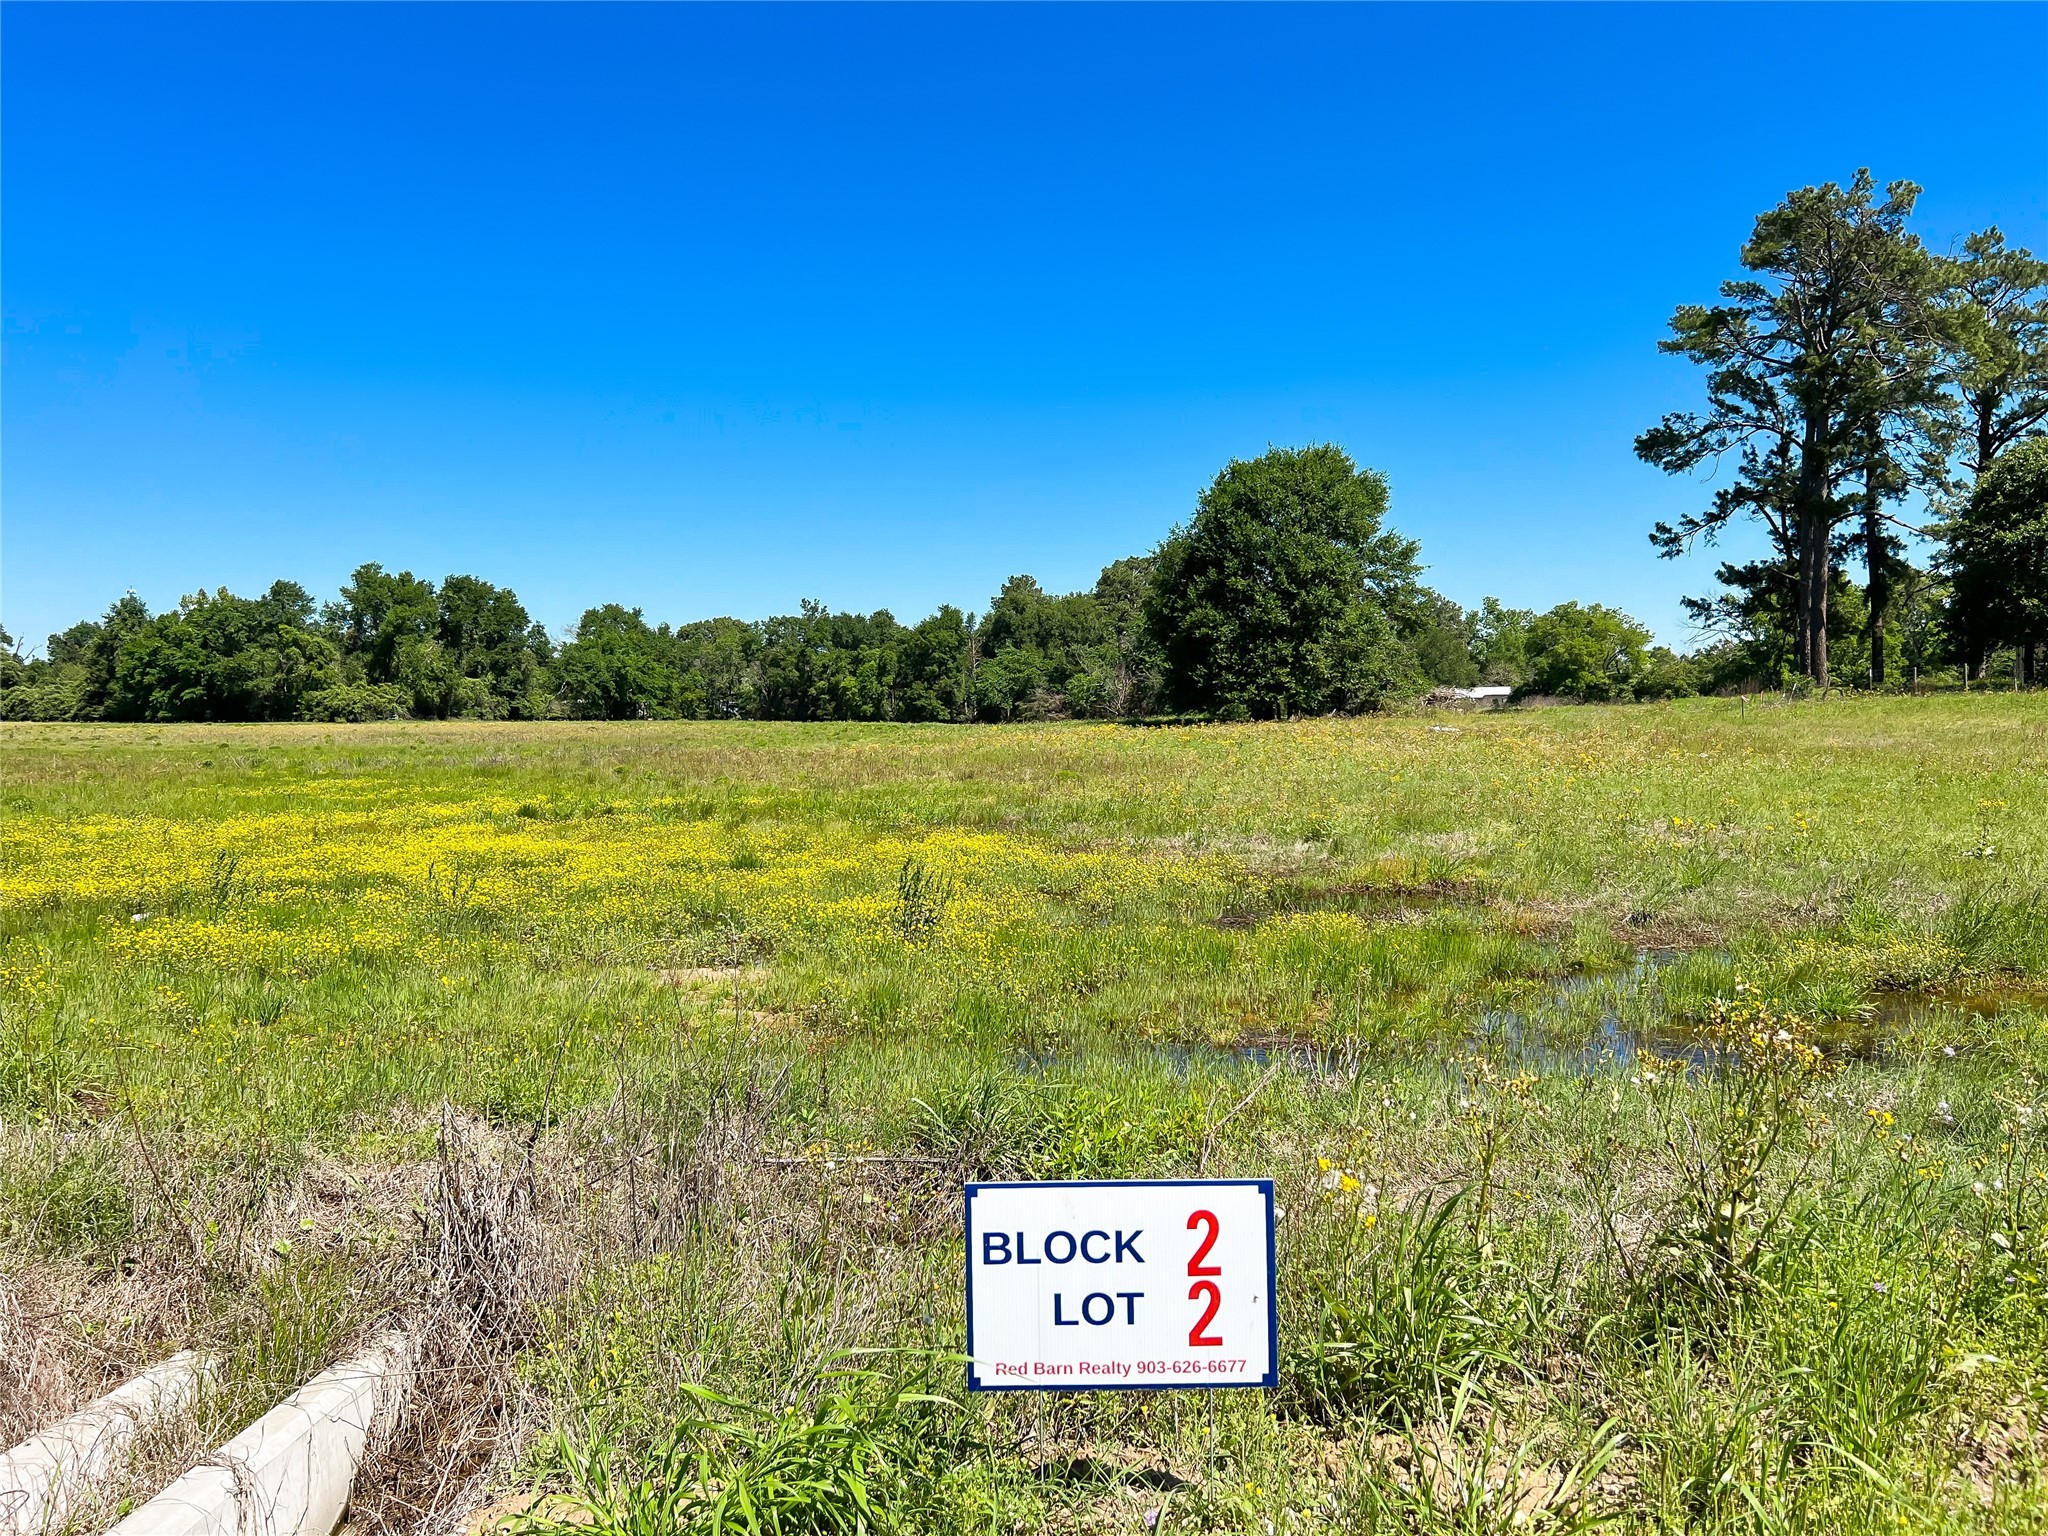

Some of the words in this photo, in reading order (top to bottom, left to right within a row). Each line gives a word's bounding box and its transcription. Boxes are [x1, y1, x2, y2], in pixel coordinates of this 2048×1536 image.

[982, 1230, 1146, 1265] BLOCK
[1186, 1209, 1222, 1277] 2
[1053, 1292, 1145, 1326] LOT
[1187, 1280, 1223, 1347] 2
[995, 1362, 1028, 1376] Red
[1033, 1361, 1073, 1376] Barn
[1079, 1360, 1132, 1378] Realty
[1136, 1359, 1247, 1375] 903-626-6677
